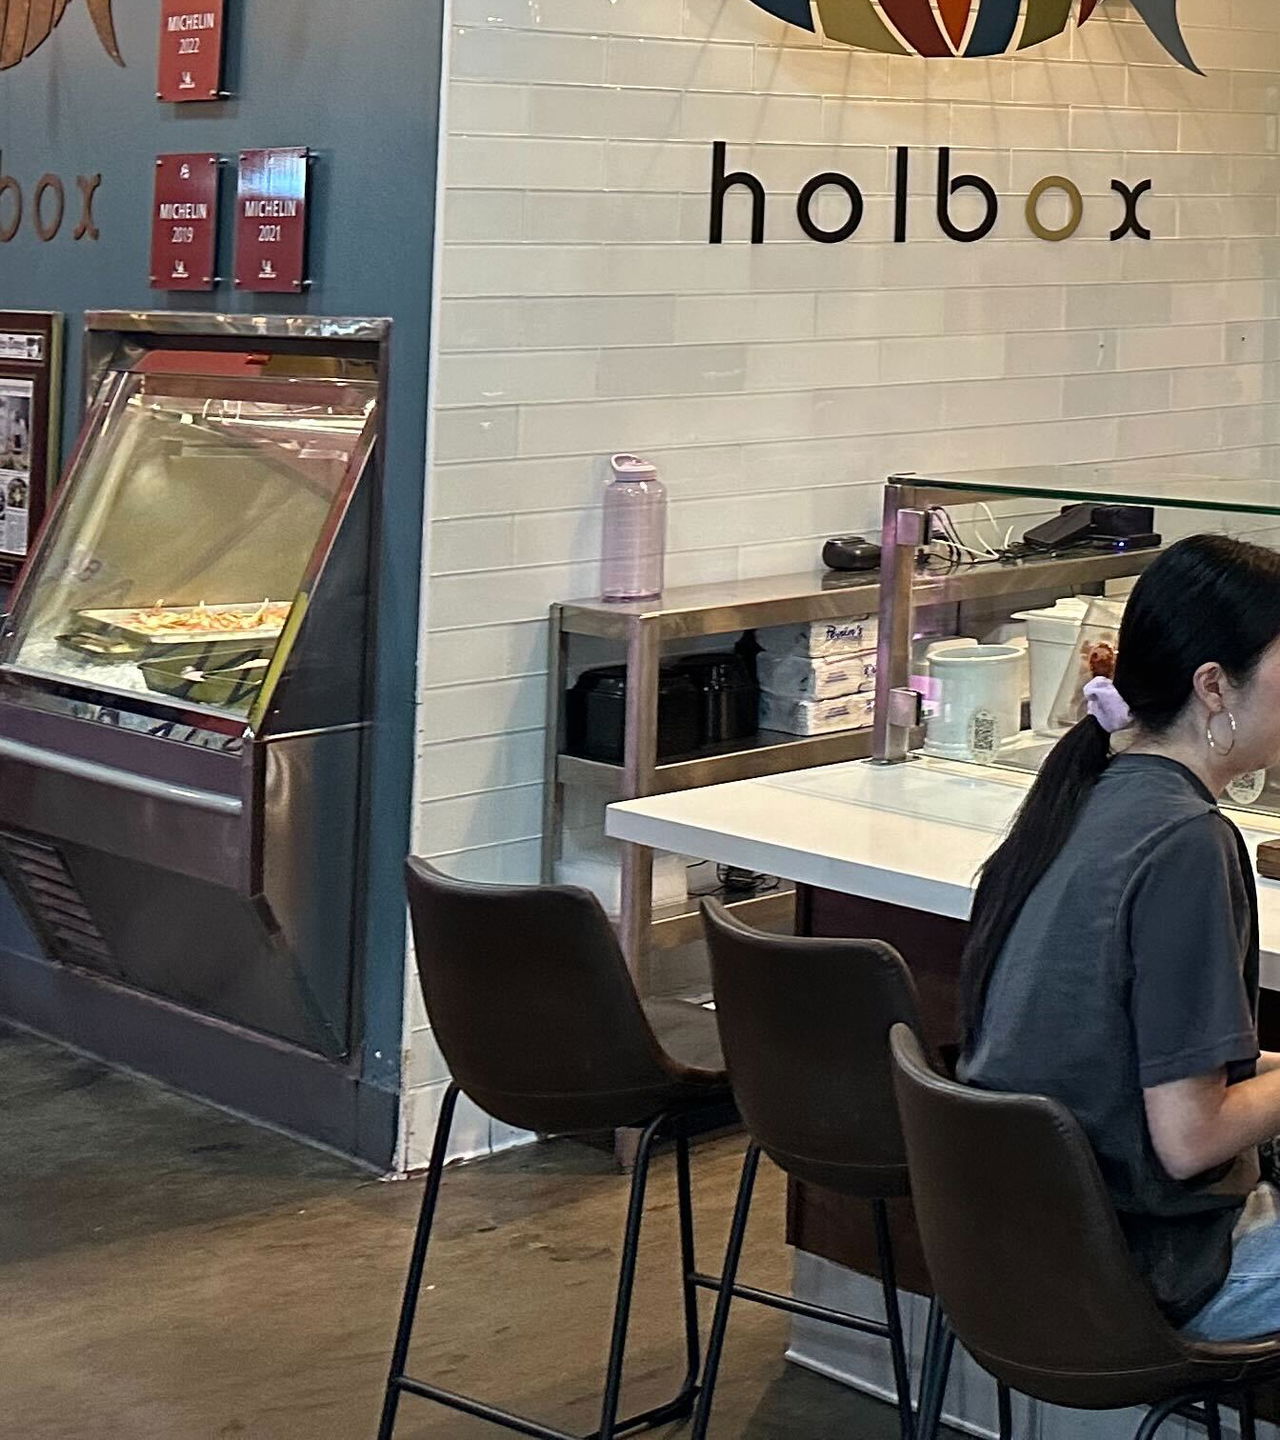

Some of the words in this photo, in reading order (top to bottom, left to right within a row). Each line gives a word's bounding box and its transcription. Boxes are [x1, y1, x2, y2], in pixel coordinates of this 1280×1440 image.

[167, 12, 216, 33] MICHELIN
[178, 37, 201, 55] 2022
[0, 149, 102, 243] box
[709, 140, 1153, 245] holbox
[159, 202, 208, 221] MICHELIN
[244, 200, 297, 218] MICHELIN
[171, 226, 195, 243] 2019
[257, 225, 282, 242] 2021
